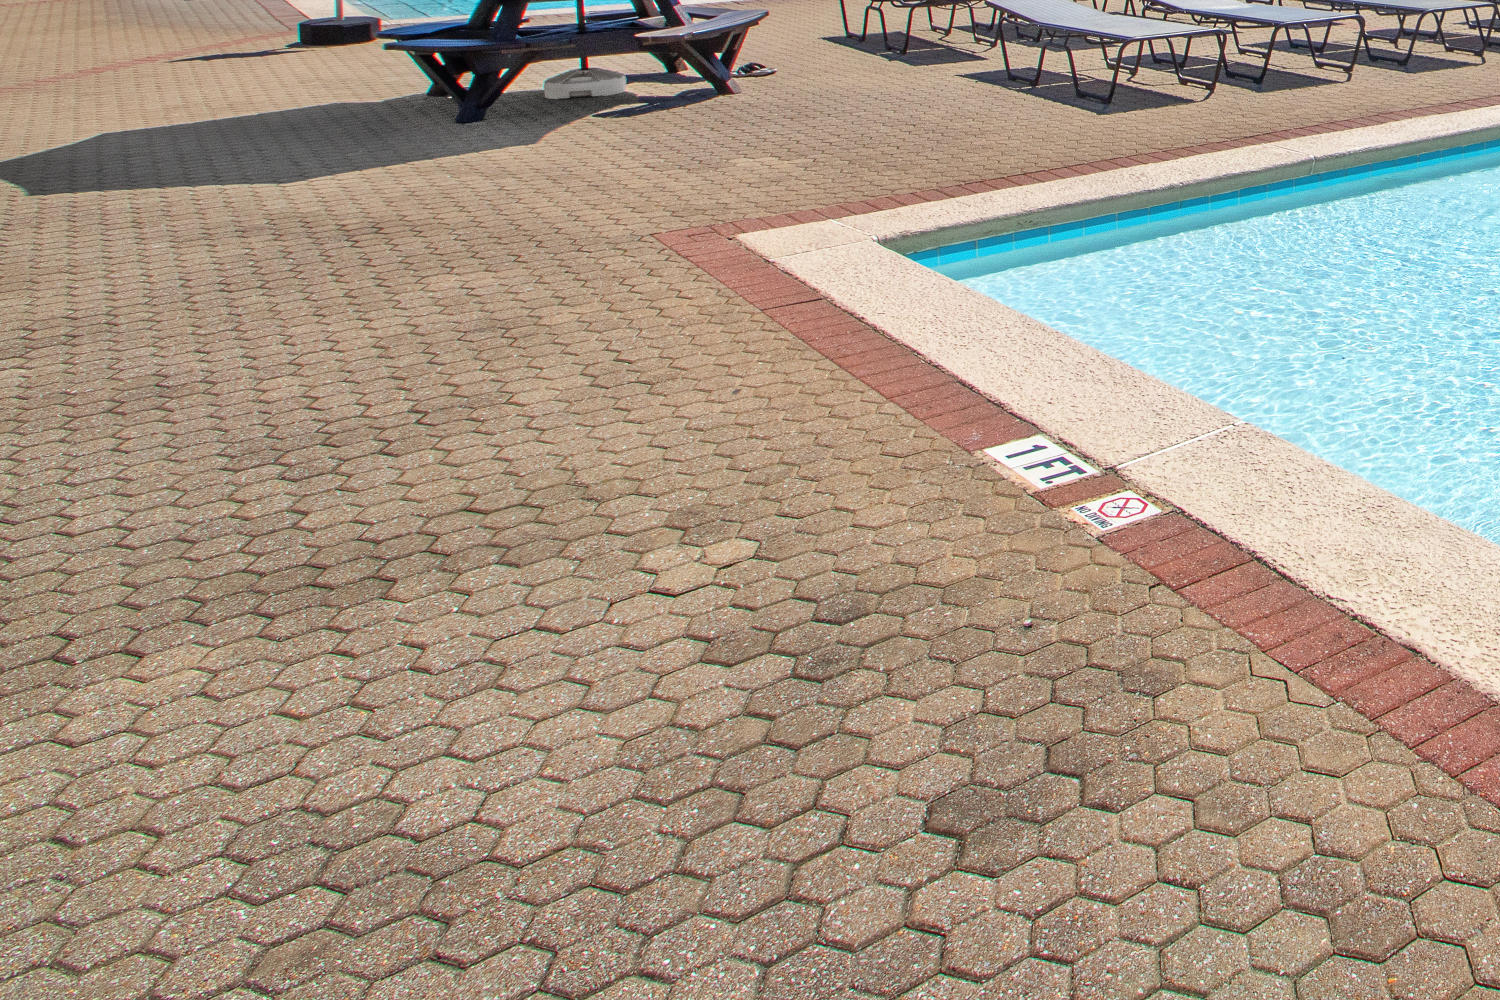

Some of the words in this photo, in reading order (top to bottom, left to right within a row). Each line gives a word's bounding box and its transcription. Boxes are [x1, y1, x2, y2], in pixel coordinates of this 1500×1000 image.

[1005, 444, 1048, 459] 1
[1075, 505, 1092, 514] NO
[1084, 512, 1113, 529] DIVING
